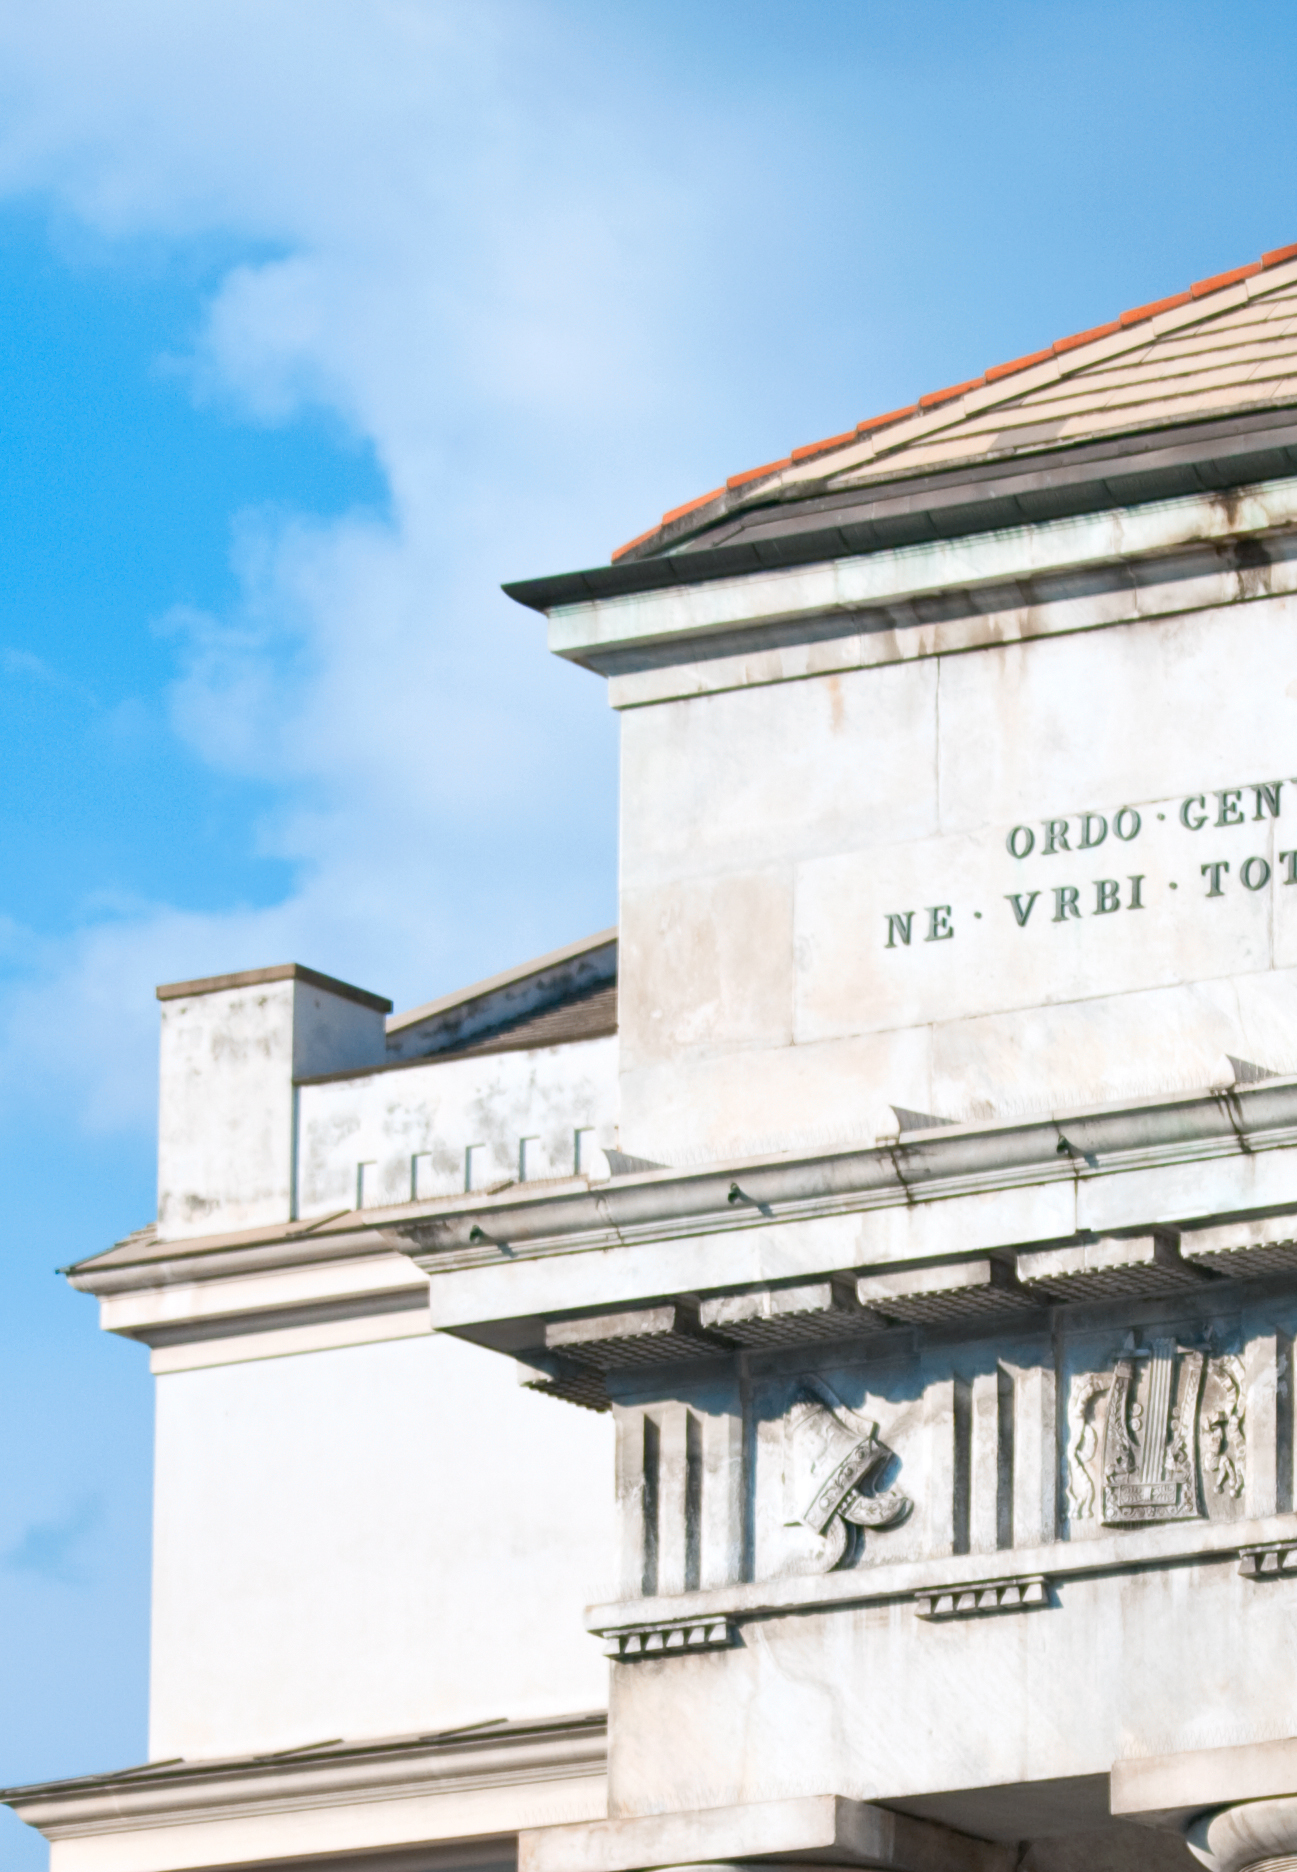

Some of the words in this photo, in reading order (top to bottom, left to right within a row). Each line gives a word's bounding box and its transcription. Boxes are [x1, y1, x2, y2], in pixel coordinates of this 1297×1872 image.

[1007, 806, 1141, 859] ORDO
[884, 905, 955, 948] NE
[1003, 874, 1146, 927] VRBI
